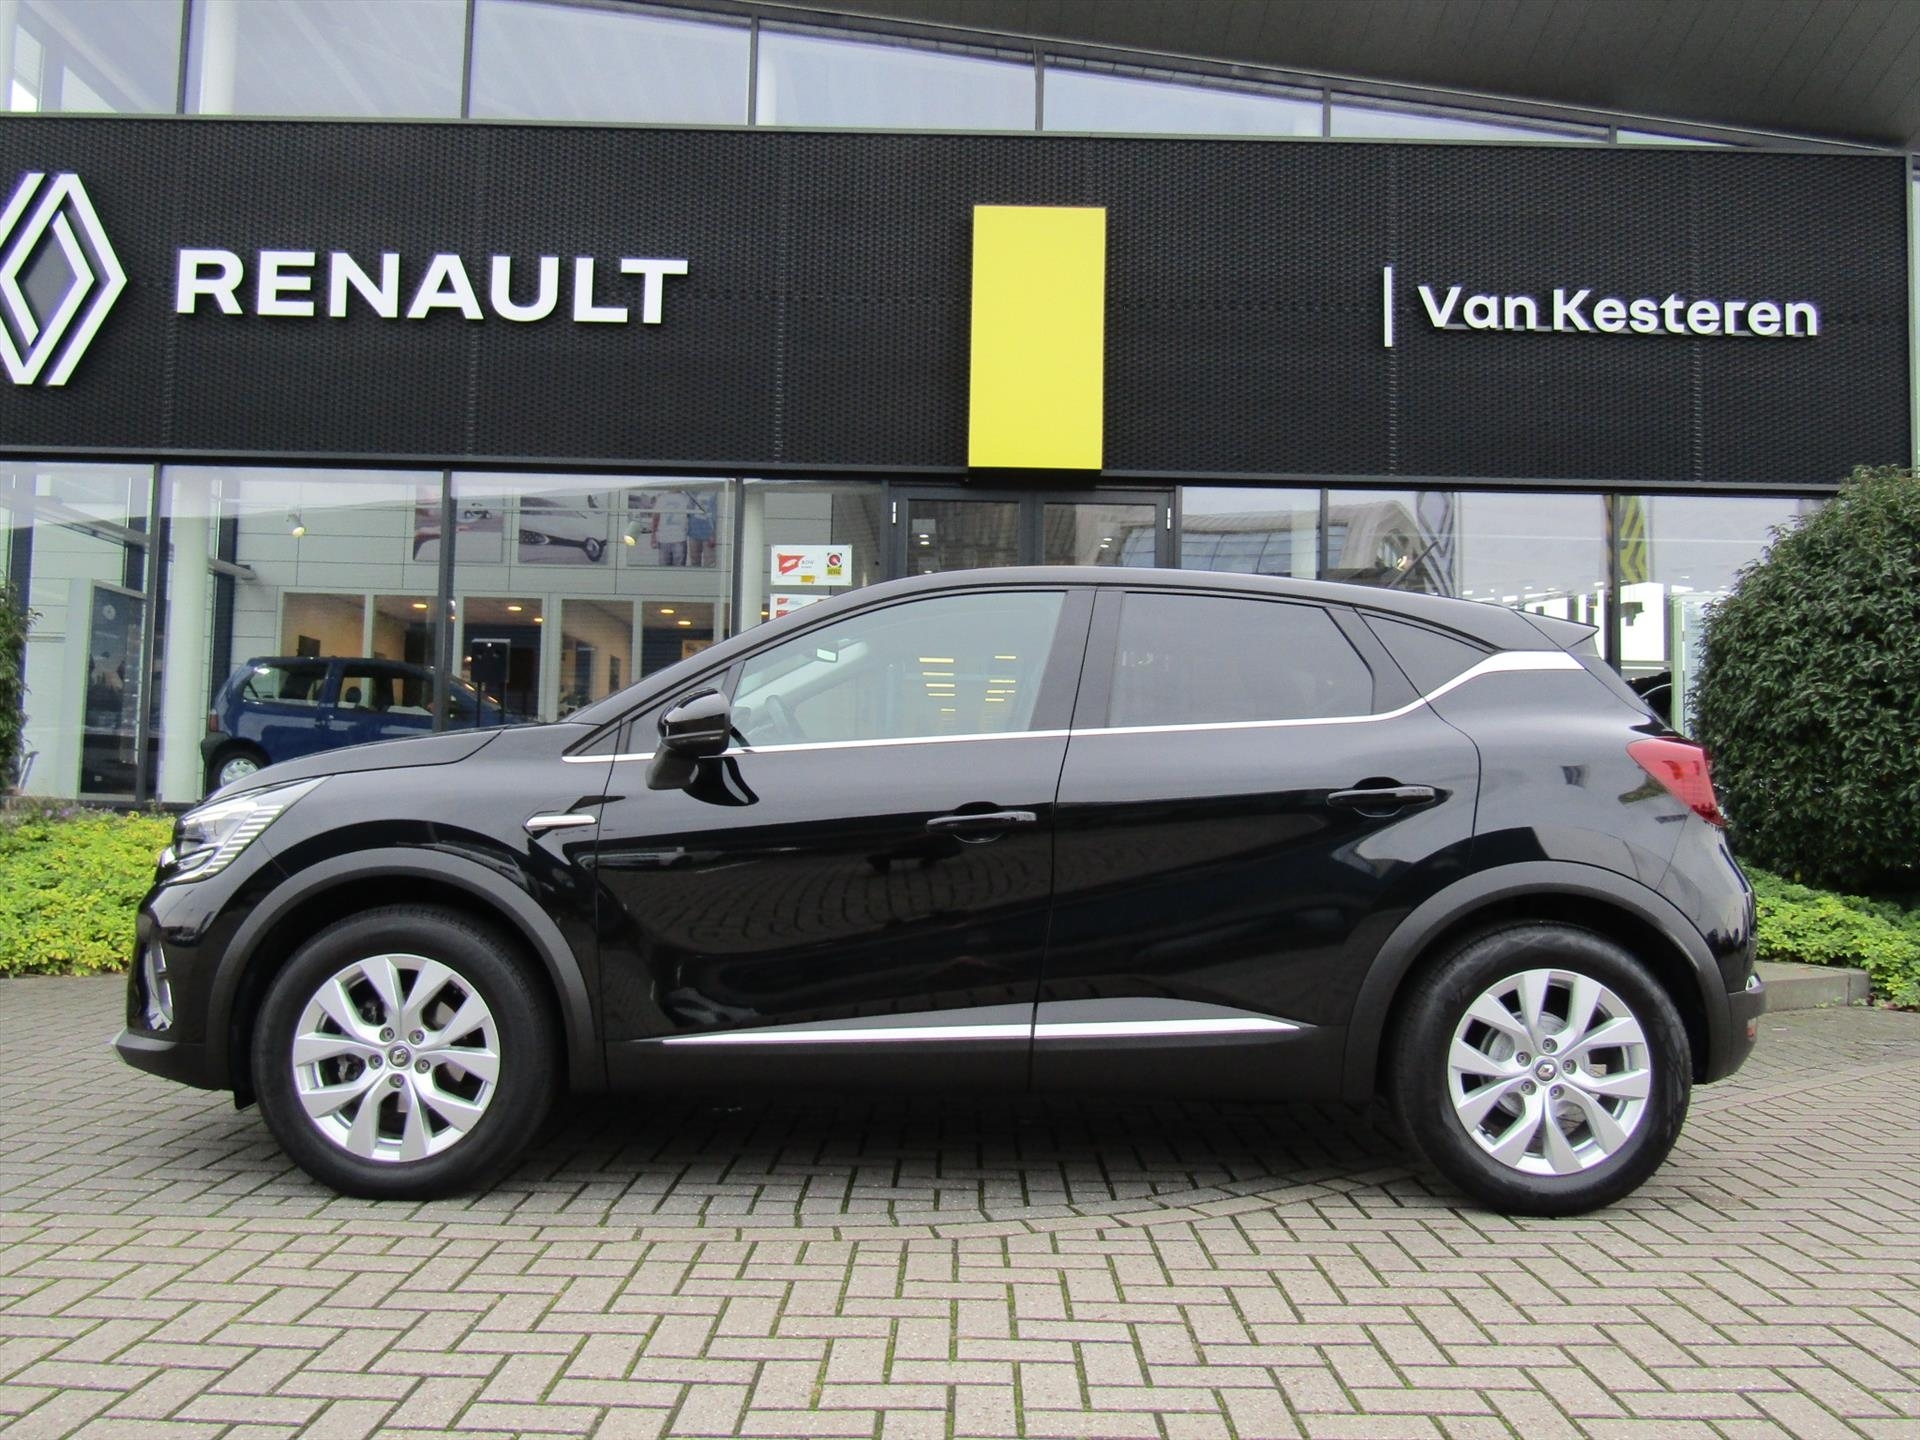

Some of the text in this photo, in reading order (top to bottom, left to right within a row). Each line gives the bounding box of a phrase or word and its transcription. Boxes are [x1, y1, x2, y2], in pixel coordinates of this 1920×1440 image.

[176, 249, 689, 324] RENAULT
[1417, 285, 1819, 337] Van Kesteren
